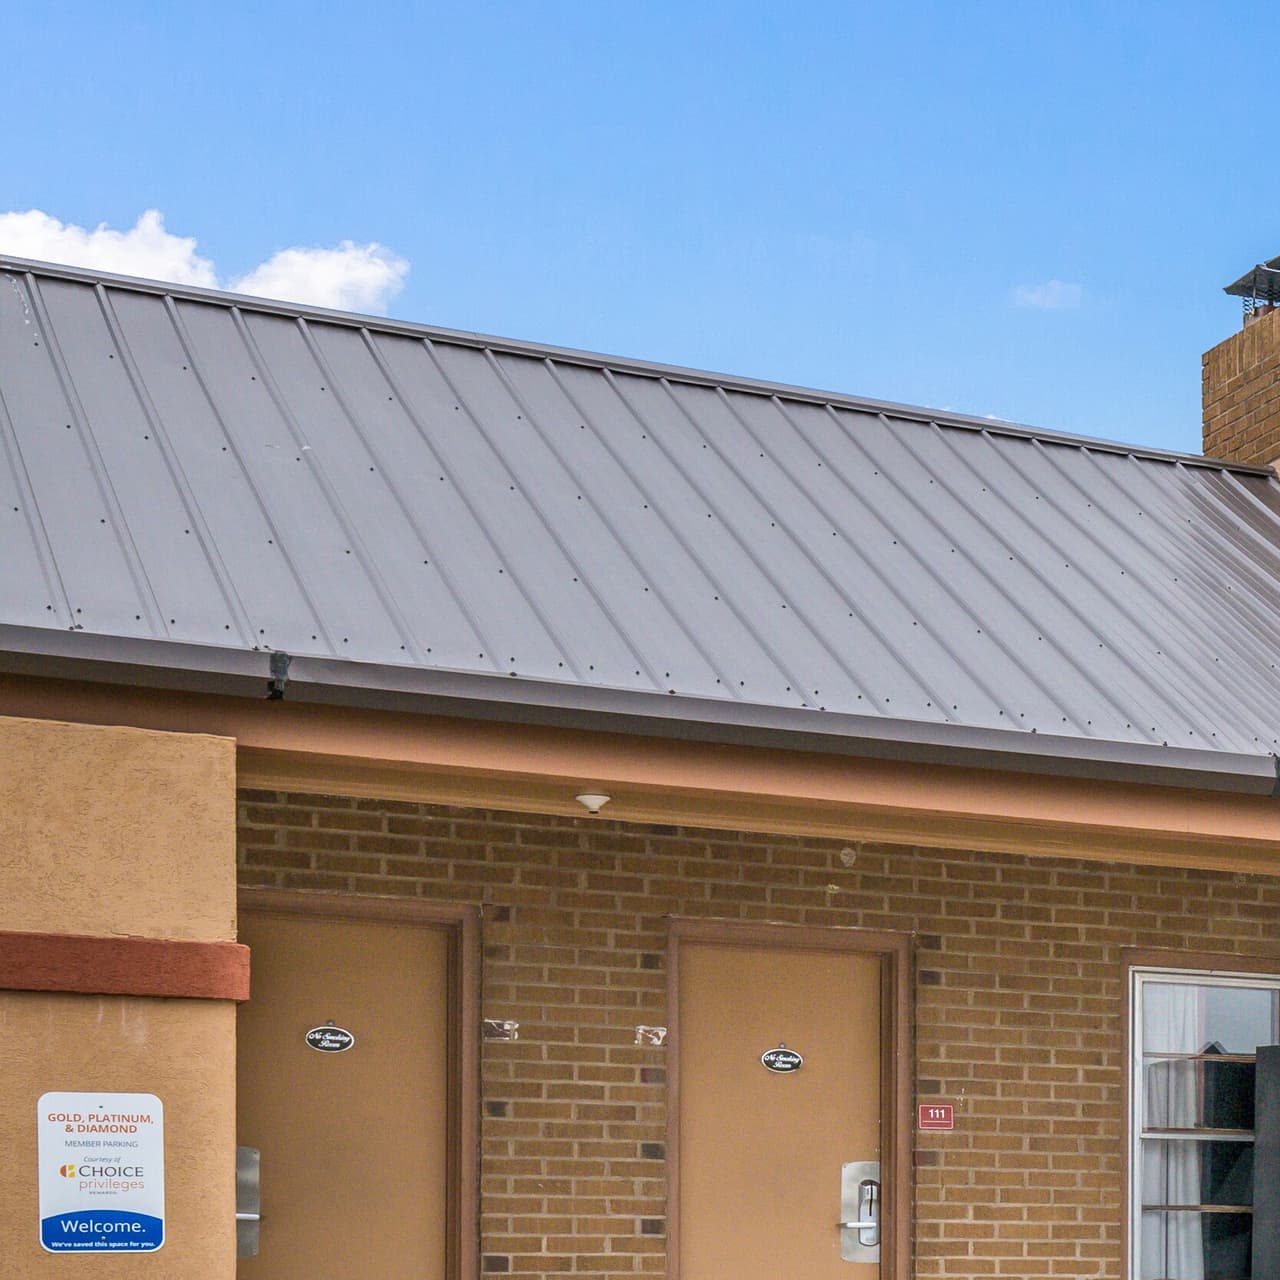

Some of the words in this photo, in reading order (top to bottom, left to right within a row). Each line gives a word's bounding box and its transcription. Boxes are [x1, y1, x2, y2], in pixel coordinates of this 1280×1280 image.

[48, 1113, 85, 1123] GOLD,
[88, 1114, 154, 1124] PLATINUM,
[929, 1109, 945, 1119] 111
[65, 1124, 74, 1133] &
[77, 1125, 137, 1134] DIAMOND
[65, 1140, 101, 1148] MEMBER
[103, 1140, 139, 1148] PARKING
[79, 1165, 144, 1177] CHOICE
[79, 1178, 144, 1192] privileges
[61, 1219, 146, 1233] Welcome.
[109, 1241, 128, 1249] space
[141, 1241, 156, 1249] you.
